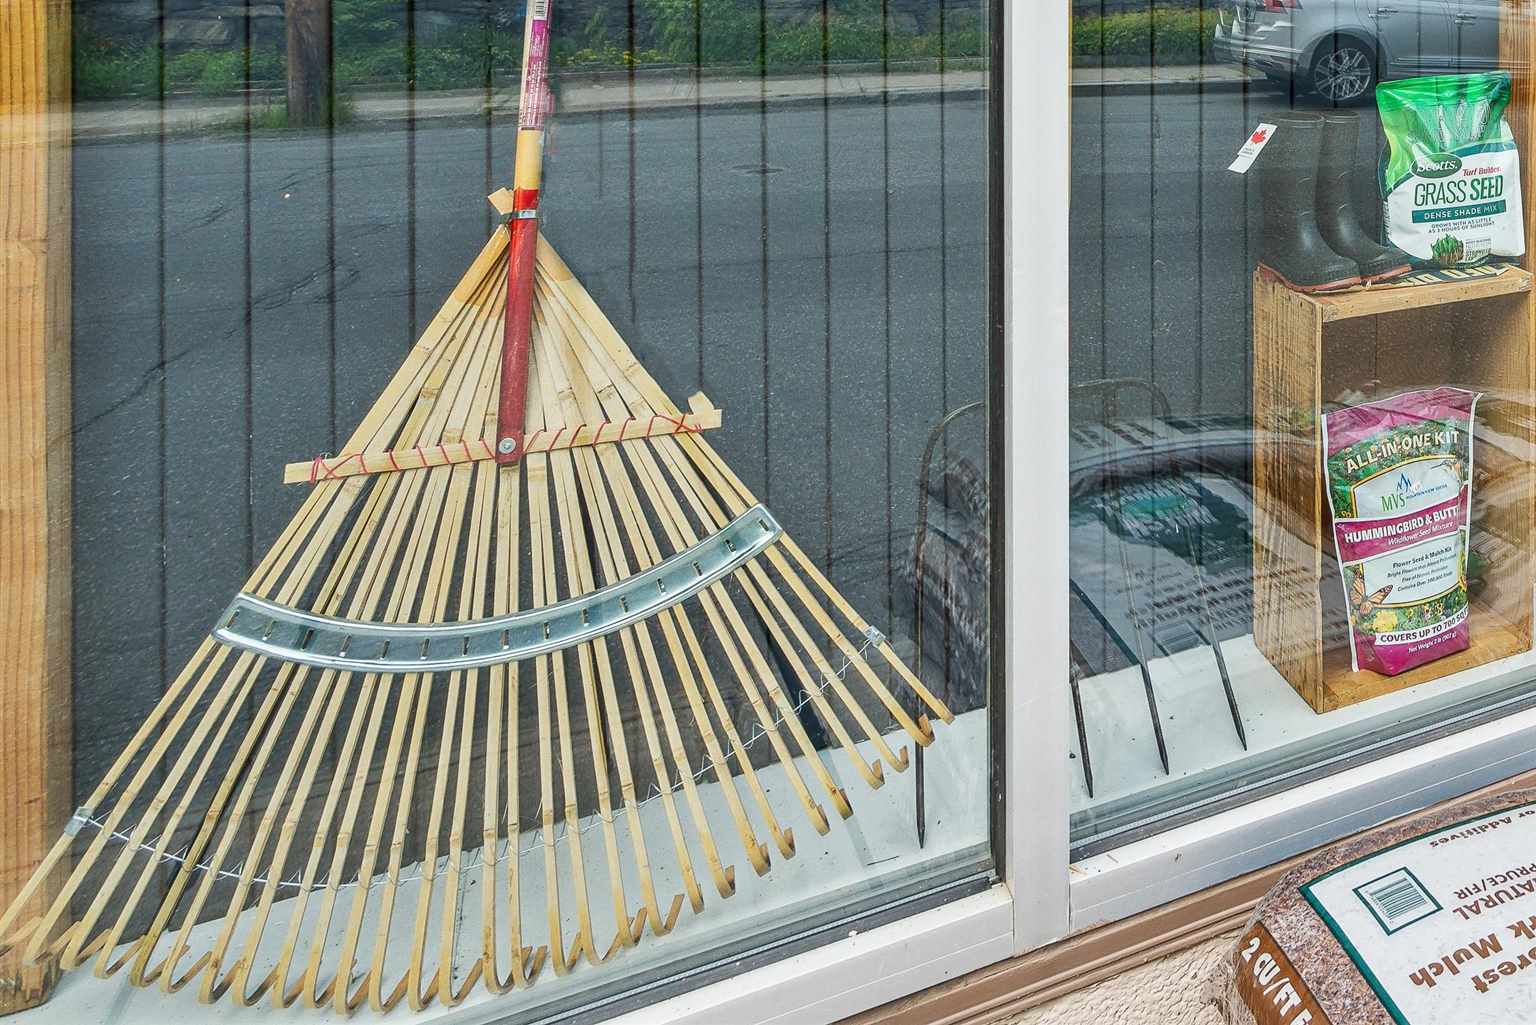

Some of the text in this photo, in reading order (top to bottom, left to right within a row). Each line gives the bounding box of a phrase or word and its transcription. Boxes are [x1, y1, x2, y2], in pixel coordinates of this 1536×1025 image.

[1463, 168, 1477, 176] Turf
[1414, 175, 1503, 206] GRASS SEED
[1424, 205, 1497, 220] DENSE SHADE MIX
[1345, 429, 1459, 474] ALL-IN-ONE KIT
[1381, 493, 1405, 512] MVS
[1345, 517, 1424, 543] HUMMINGBIRD
[1425, 514, 1432, 525] &
[1388, 533, 1419, 546] Wildflower
[1419, 527, 1431, 537] Seed
[1380, 618, 1456, 642] COVERS UP TO 700
[1429, 816, 1512, 848] Additives
[1409, 933, 1503, 989] Mulch
[1241, 936, 1261, 962] 2
[1253, 952, 1302, 1017] CU/FT
